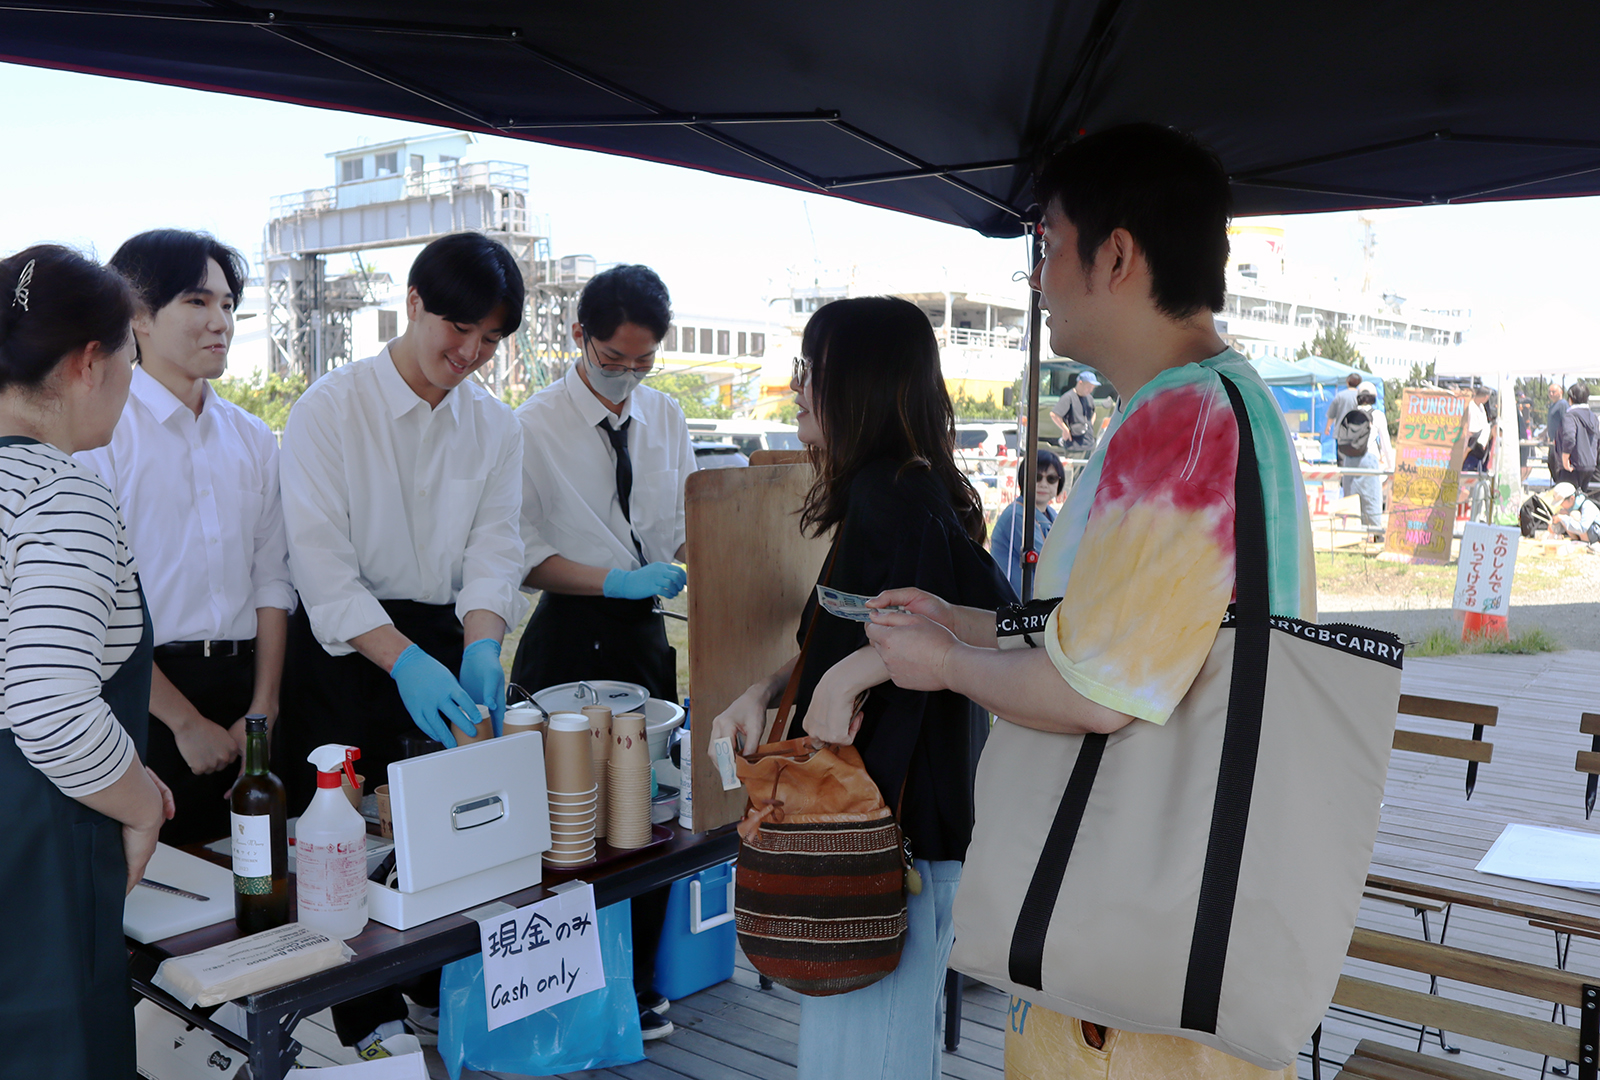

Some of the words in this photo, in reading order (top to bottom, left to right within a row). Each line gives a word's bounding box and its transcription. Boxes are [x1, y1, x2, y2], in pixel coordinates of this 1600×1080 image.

[1408, 395, 1465, 416] RUNRUN
[1488, 533, 1508, 593] たのしんで
[488, 912, 592, 958] 現金のみ
[491, 976, 529, 1009] Cash
[537, 957, 580, 993] only
